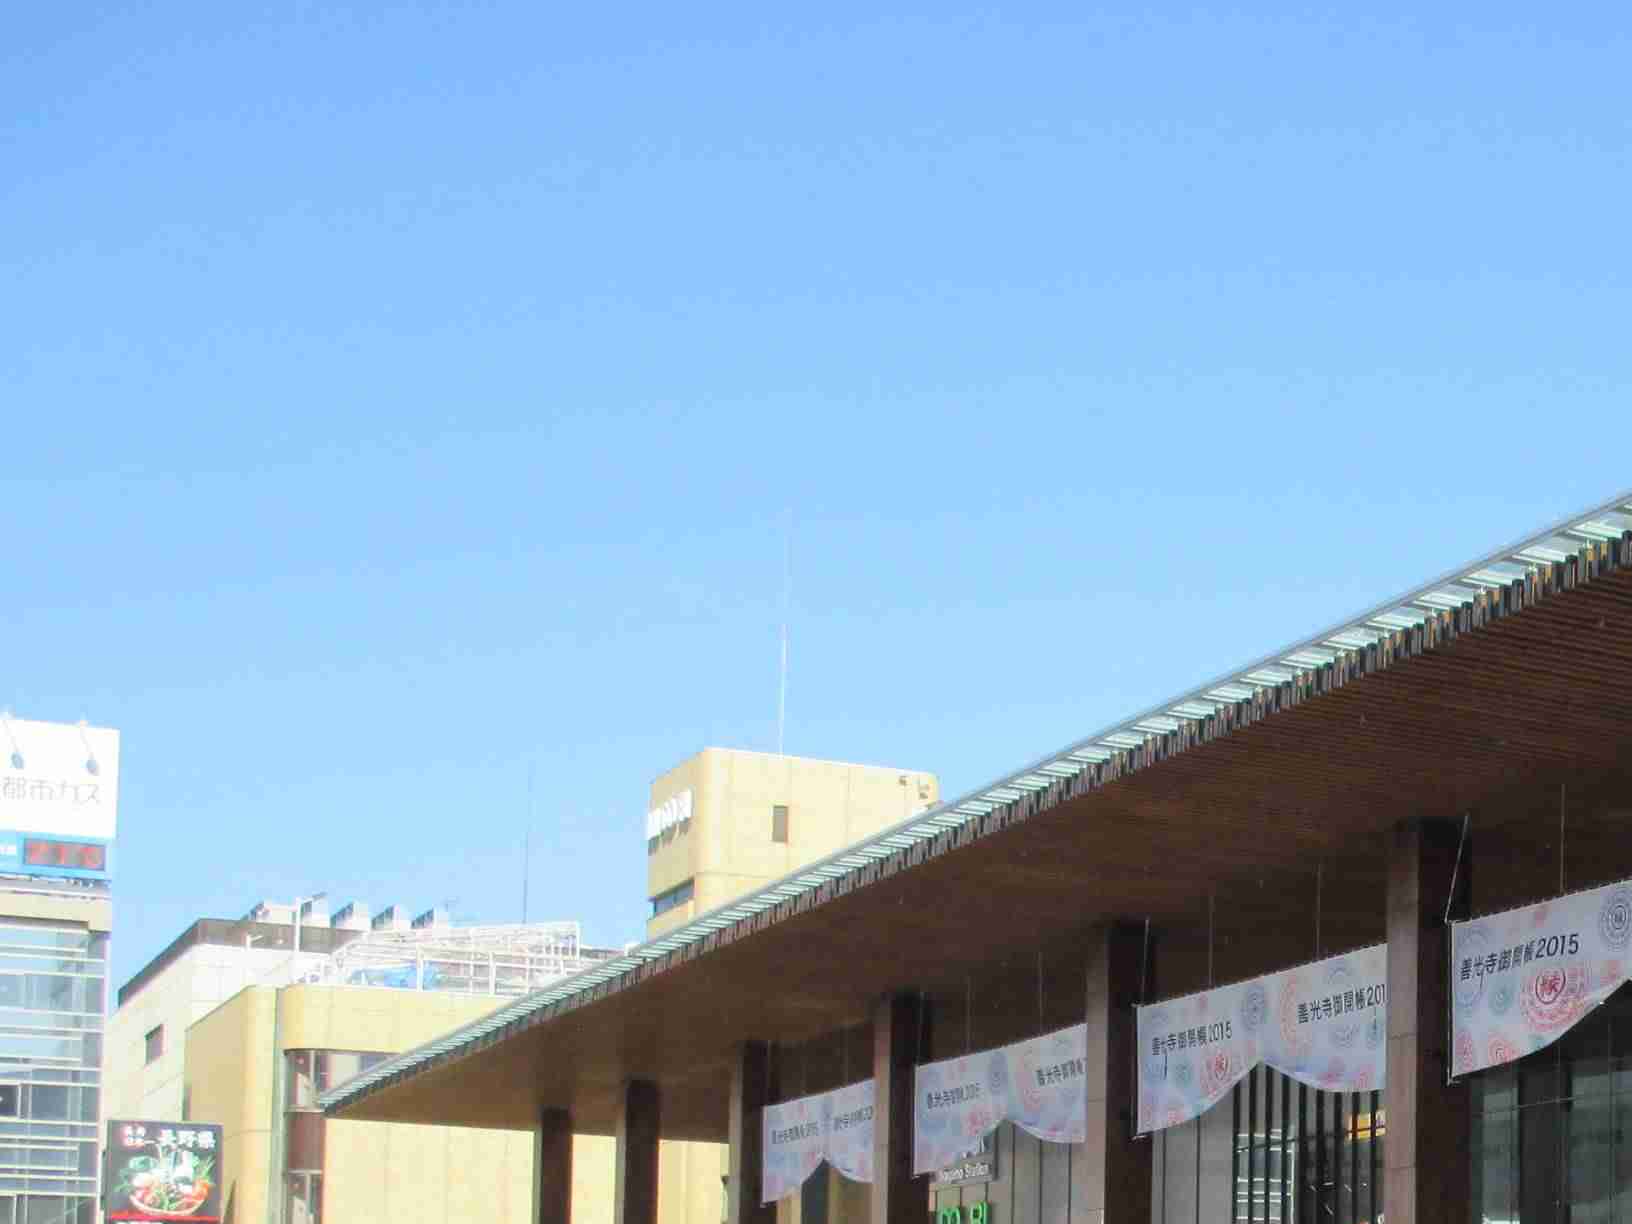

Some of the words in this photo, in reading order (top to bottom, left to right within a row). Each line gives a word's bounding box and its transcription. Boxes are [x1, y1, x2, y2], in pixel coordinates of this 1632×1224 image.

[1459, 933, 1580, 981] 善光寺御開帳2015
[1297, 983, 1386, 1024] 善光寺御開帳201
